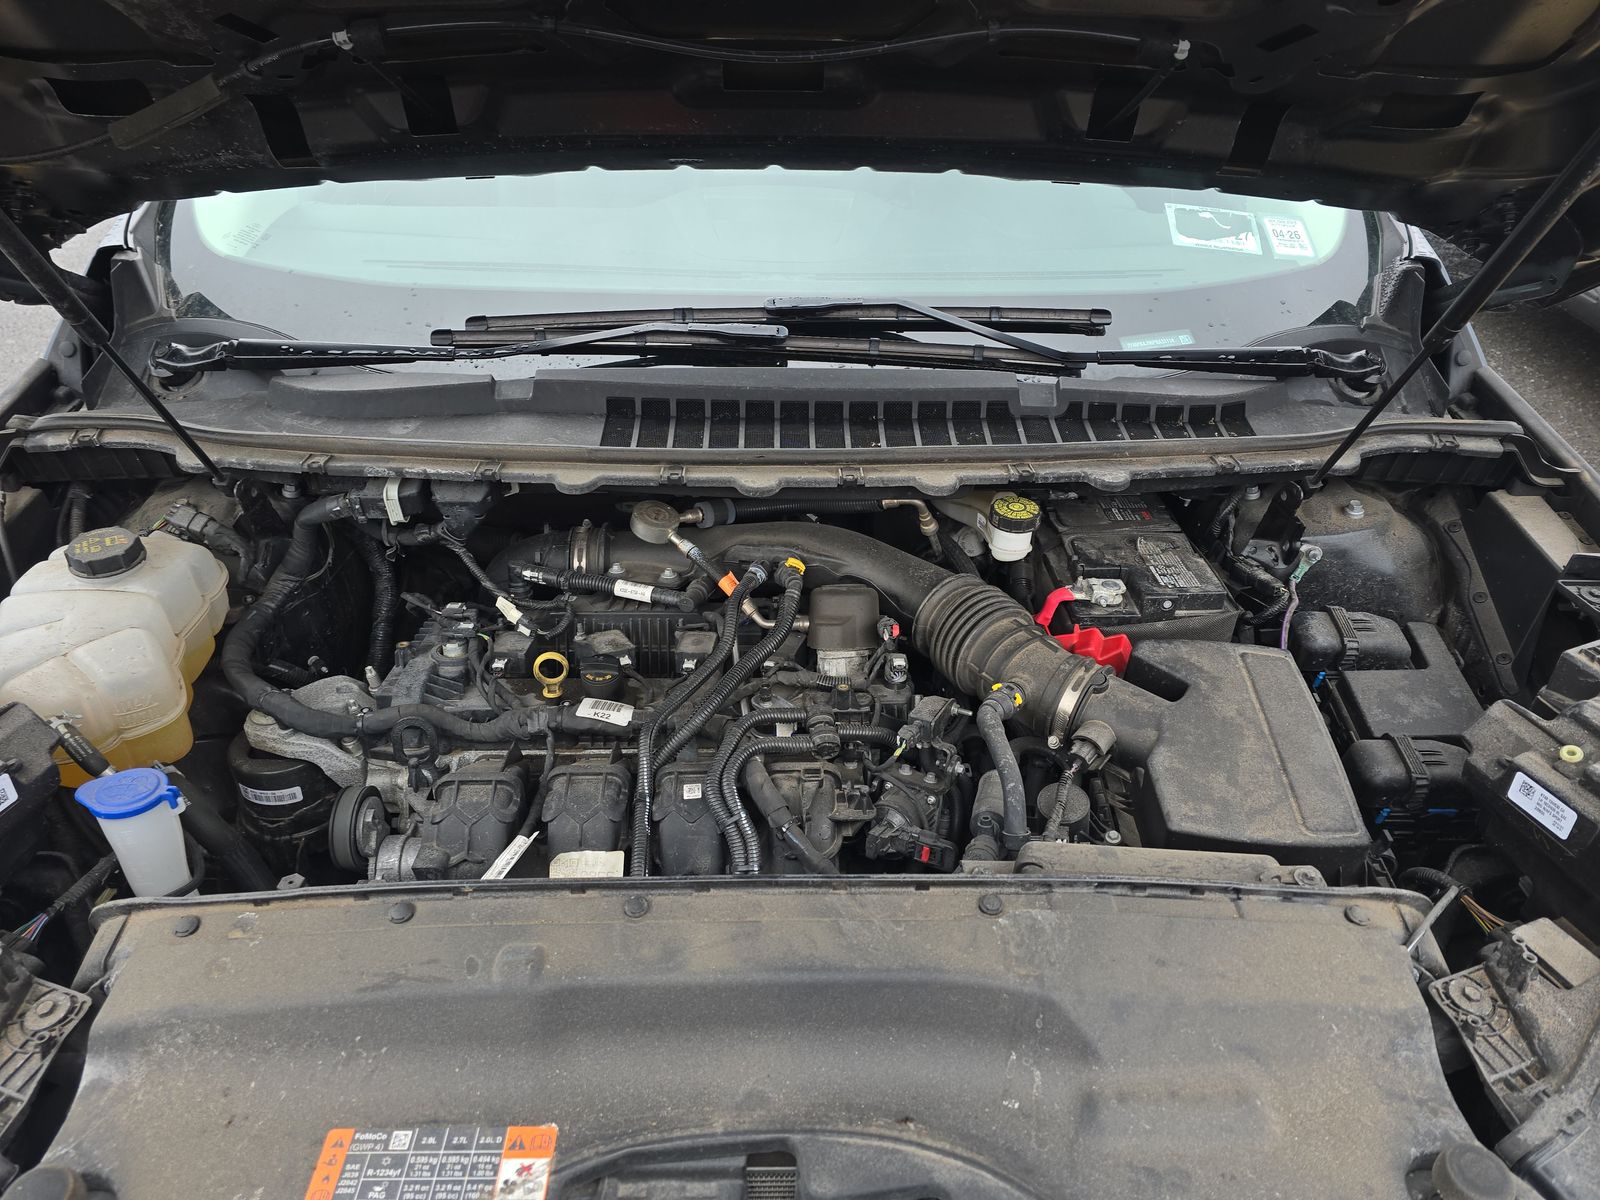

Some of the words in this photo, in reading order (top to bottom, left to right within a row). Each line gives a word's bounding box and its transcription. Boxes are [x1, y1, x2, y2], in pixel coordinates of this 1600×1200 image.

[593, 711, 611, 720] K22
[354, 1132, 387, 1140] FoMoCo
[452, 1136, 468, 1144] 2.7L
[429, 1156, 438, 1165] kg
[460, 1156, 470, 1165] kg
[366, 1169, 402, 1178] R-1234yf
[368, 1191, 386, 1199] PAG
